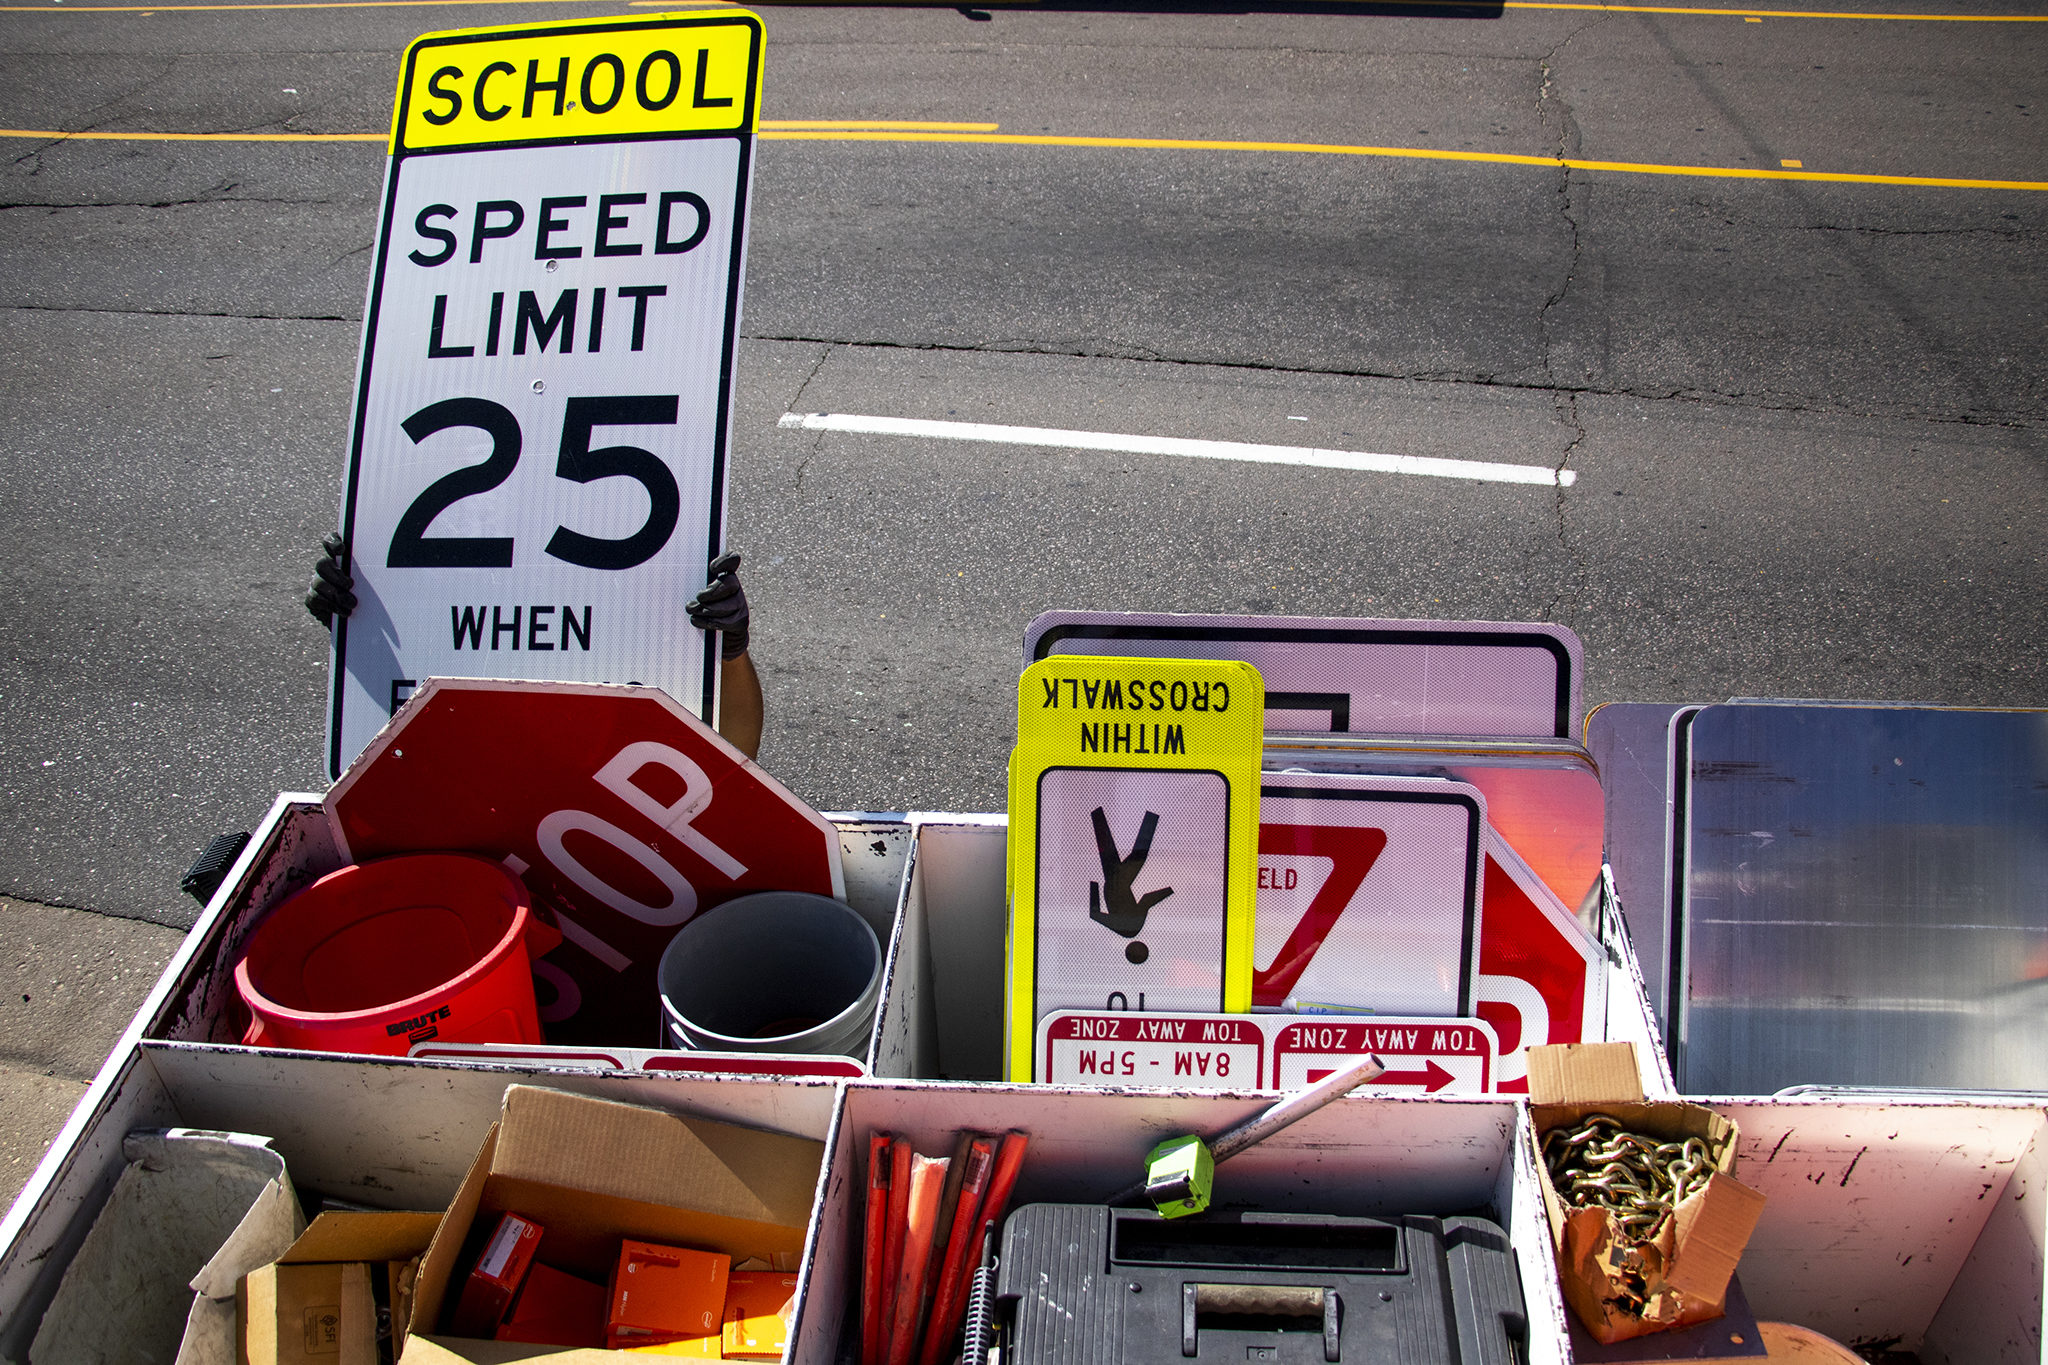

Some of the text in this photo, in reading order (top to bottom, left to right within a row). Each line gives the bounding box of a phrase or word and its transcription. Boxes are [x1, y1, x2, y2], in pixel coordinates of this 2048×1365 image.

[422, 49, 734, 126] SCHOOL
[407, 191, 711, 268] SPEED
[428, 285, 667, 359] LIMIT
[386, 394, 680, 570] 25
[451, 605, 592, 651] WHEN
[1042, 678, 1230, 712] CROSSWALK
[1081, 722, 1186, 755] WITHIN
[1257, 867, 1298, 890] ELD
[386, 1004, 451, 1037] BRUTE
[1070, 1019, 1241, 1041] TOW AWAY ZONE
[1290, 1027, 1476, 1051] TOW AWAY ZONE
[1079, 1050, 1136, 1075] 5PM
[1174, 1052, 1231, 1077] 8AM
